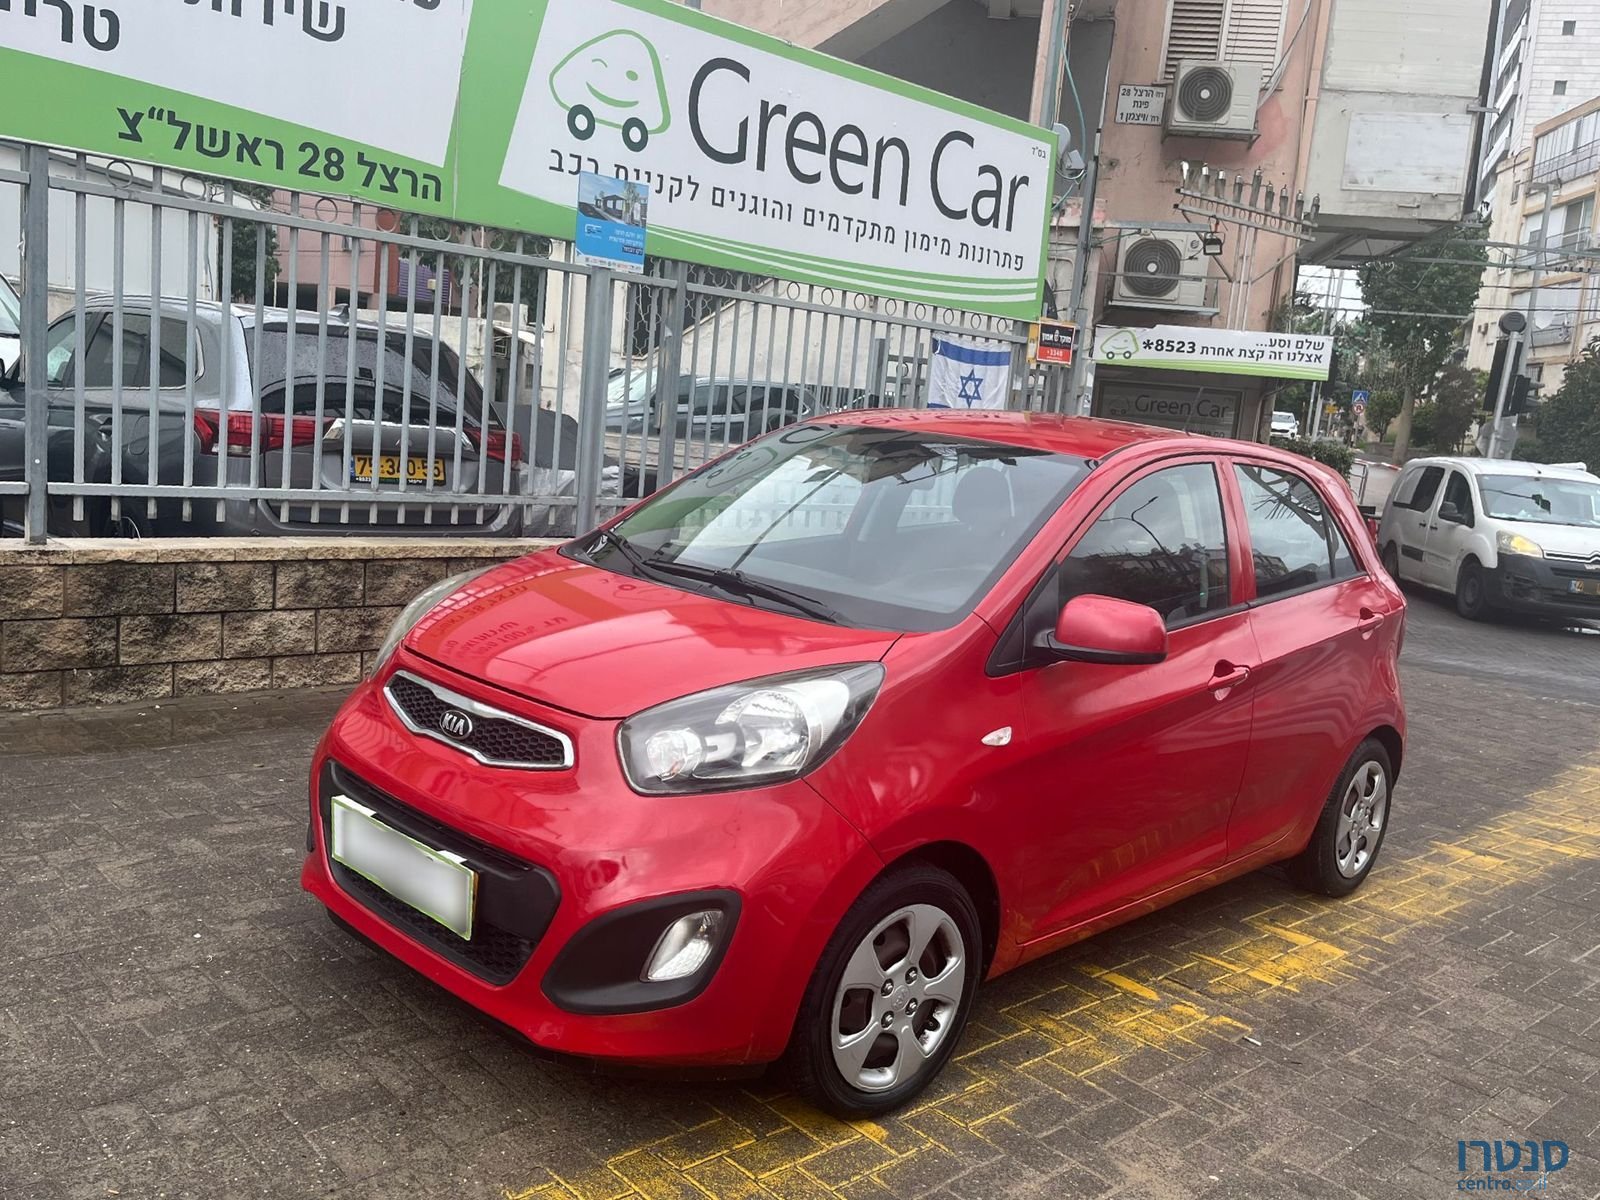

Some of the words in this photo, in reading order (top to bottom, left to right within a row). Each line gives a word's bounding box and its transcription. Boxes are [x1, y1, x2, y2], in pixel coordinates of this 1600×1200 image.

[1120, 88, 1131, 97] 28
[1133, 87, 1154, 98] הרצל
[1132, 99, 1149, 109] פינת
[1119, 112, 1124, 121] 1
[688, 57, 910, 207] Green
[930, 130, 1030, 232] Car
[298, 141, 345, 182] 28
[357, 151, 442, 202] הרצל
[711, 186, 793, 222] והוגנים
[803, 207, 896, 244] מתקדמים
[904, 230, 951, 257] מימון
[958, 242, 1024, 271] פתרונות
[1199, 345, 1235, 357] אחרת
[1295, 338, 1325, 351] שלם
[1237, 348, 1265, 361] קצת
[1268, 350, 1283, 361] זה
[1287, 350, 1323, 364] אצלנו
[1134, 394, 1191, 416] Green
[1196, 398, 1230, 418] Car
[442, 712, 466, 736] KIA
